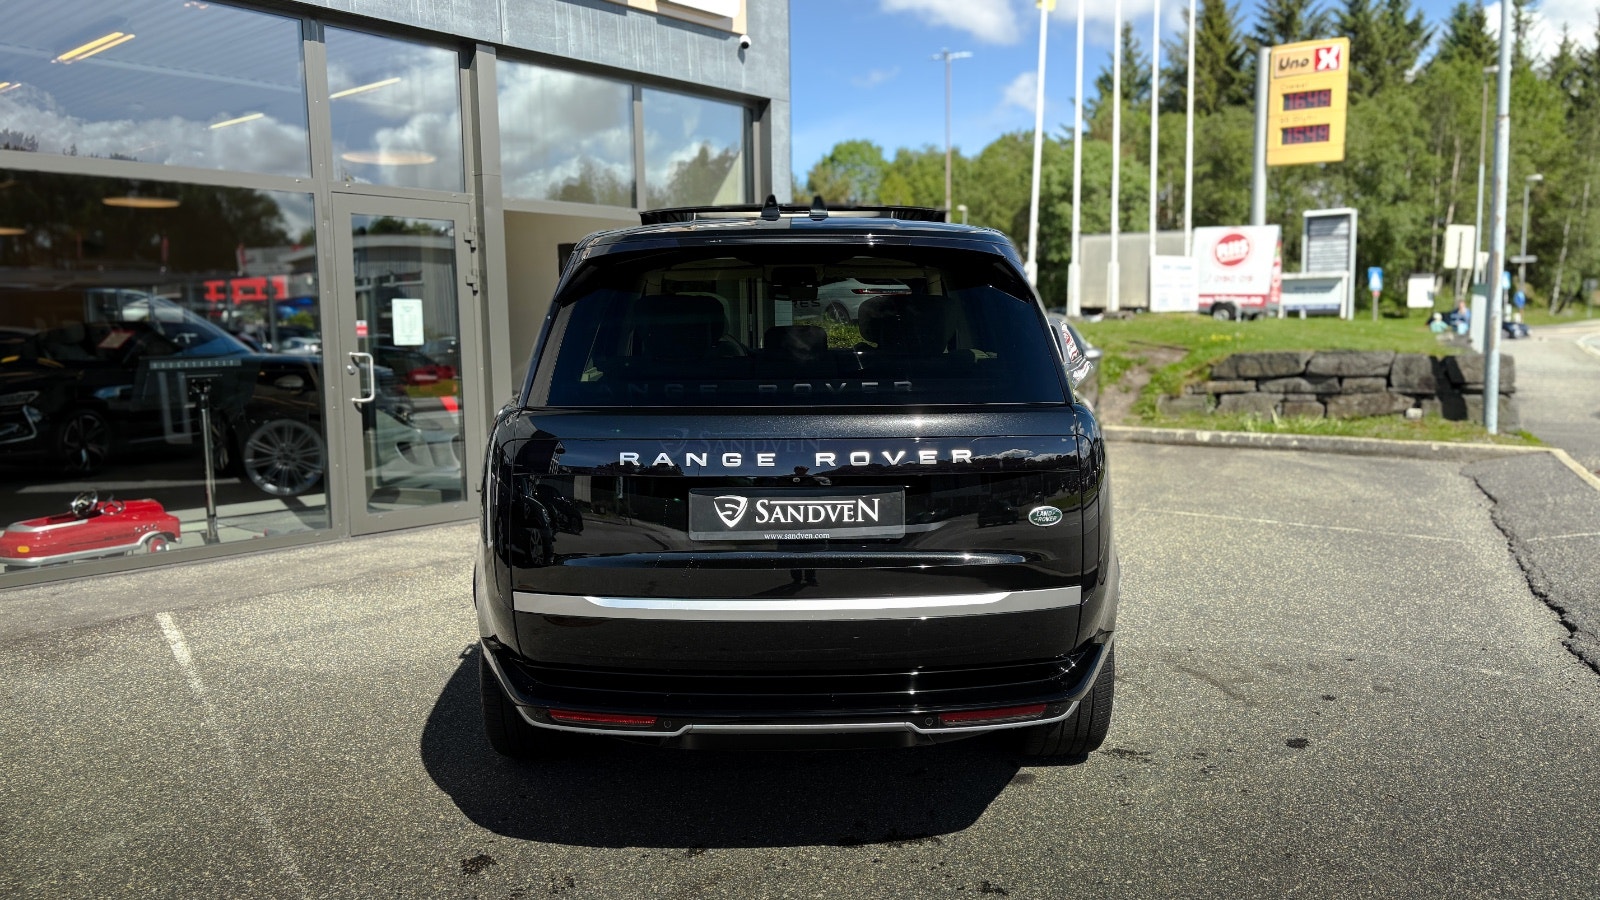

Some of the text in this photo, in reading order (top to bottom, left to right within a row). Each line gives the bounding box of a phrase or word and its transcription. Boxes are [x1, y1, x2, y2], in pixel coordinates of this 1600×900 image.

[1278, 45, 1341, 71] Uno X
[619, 449, 973, 467] RANGE ROVER
[755, 498, 881, 523] SANDVEN
[764, 532, 830, 540] www.sandven.com
